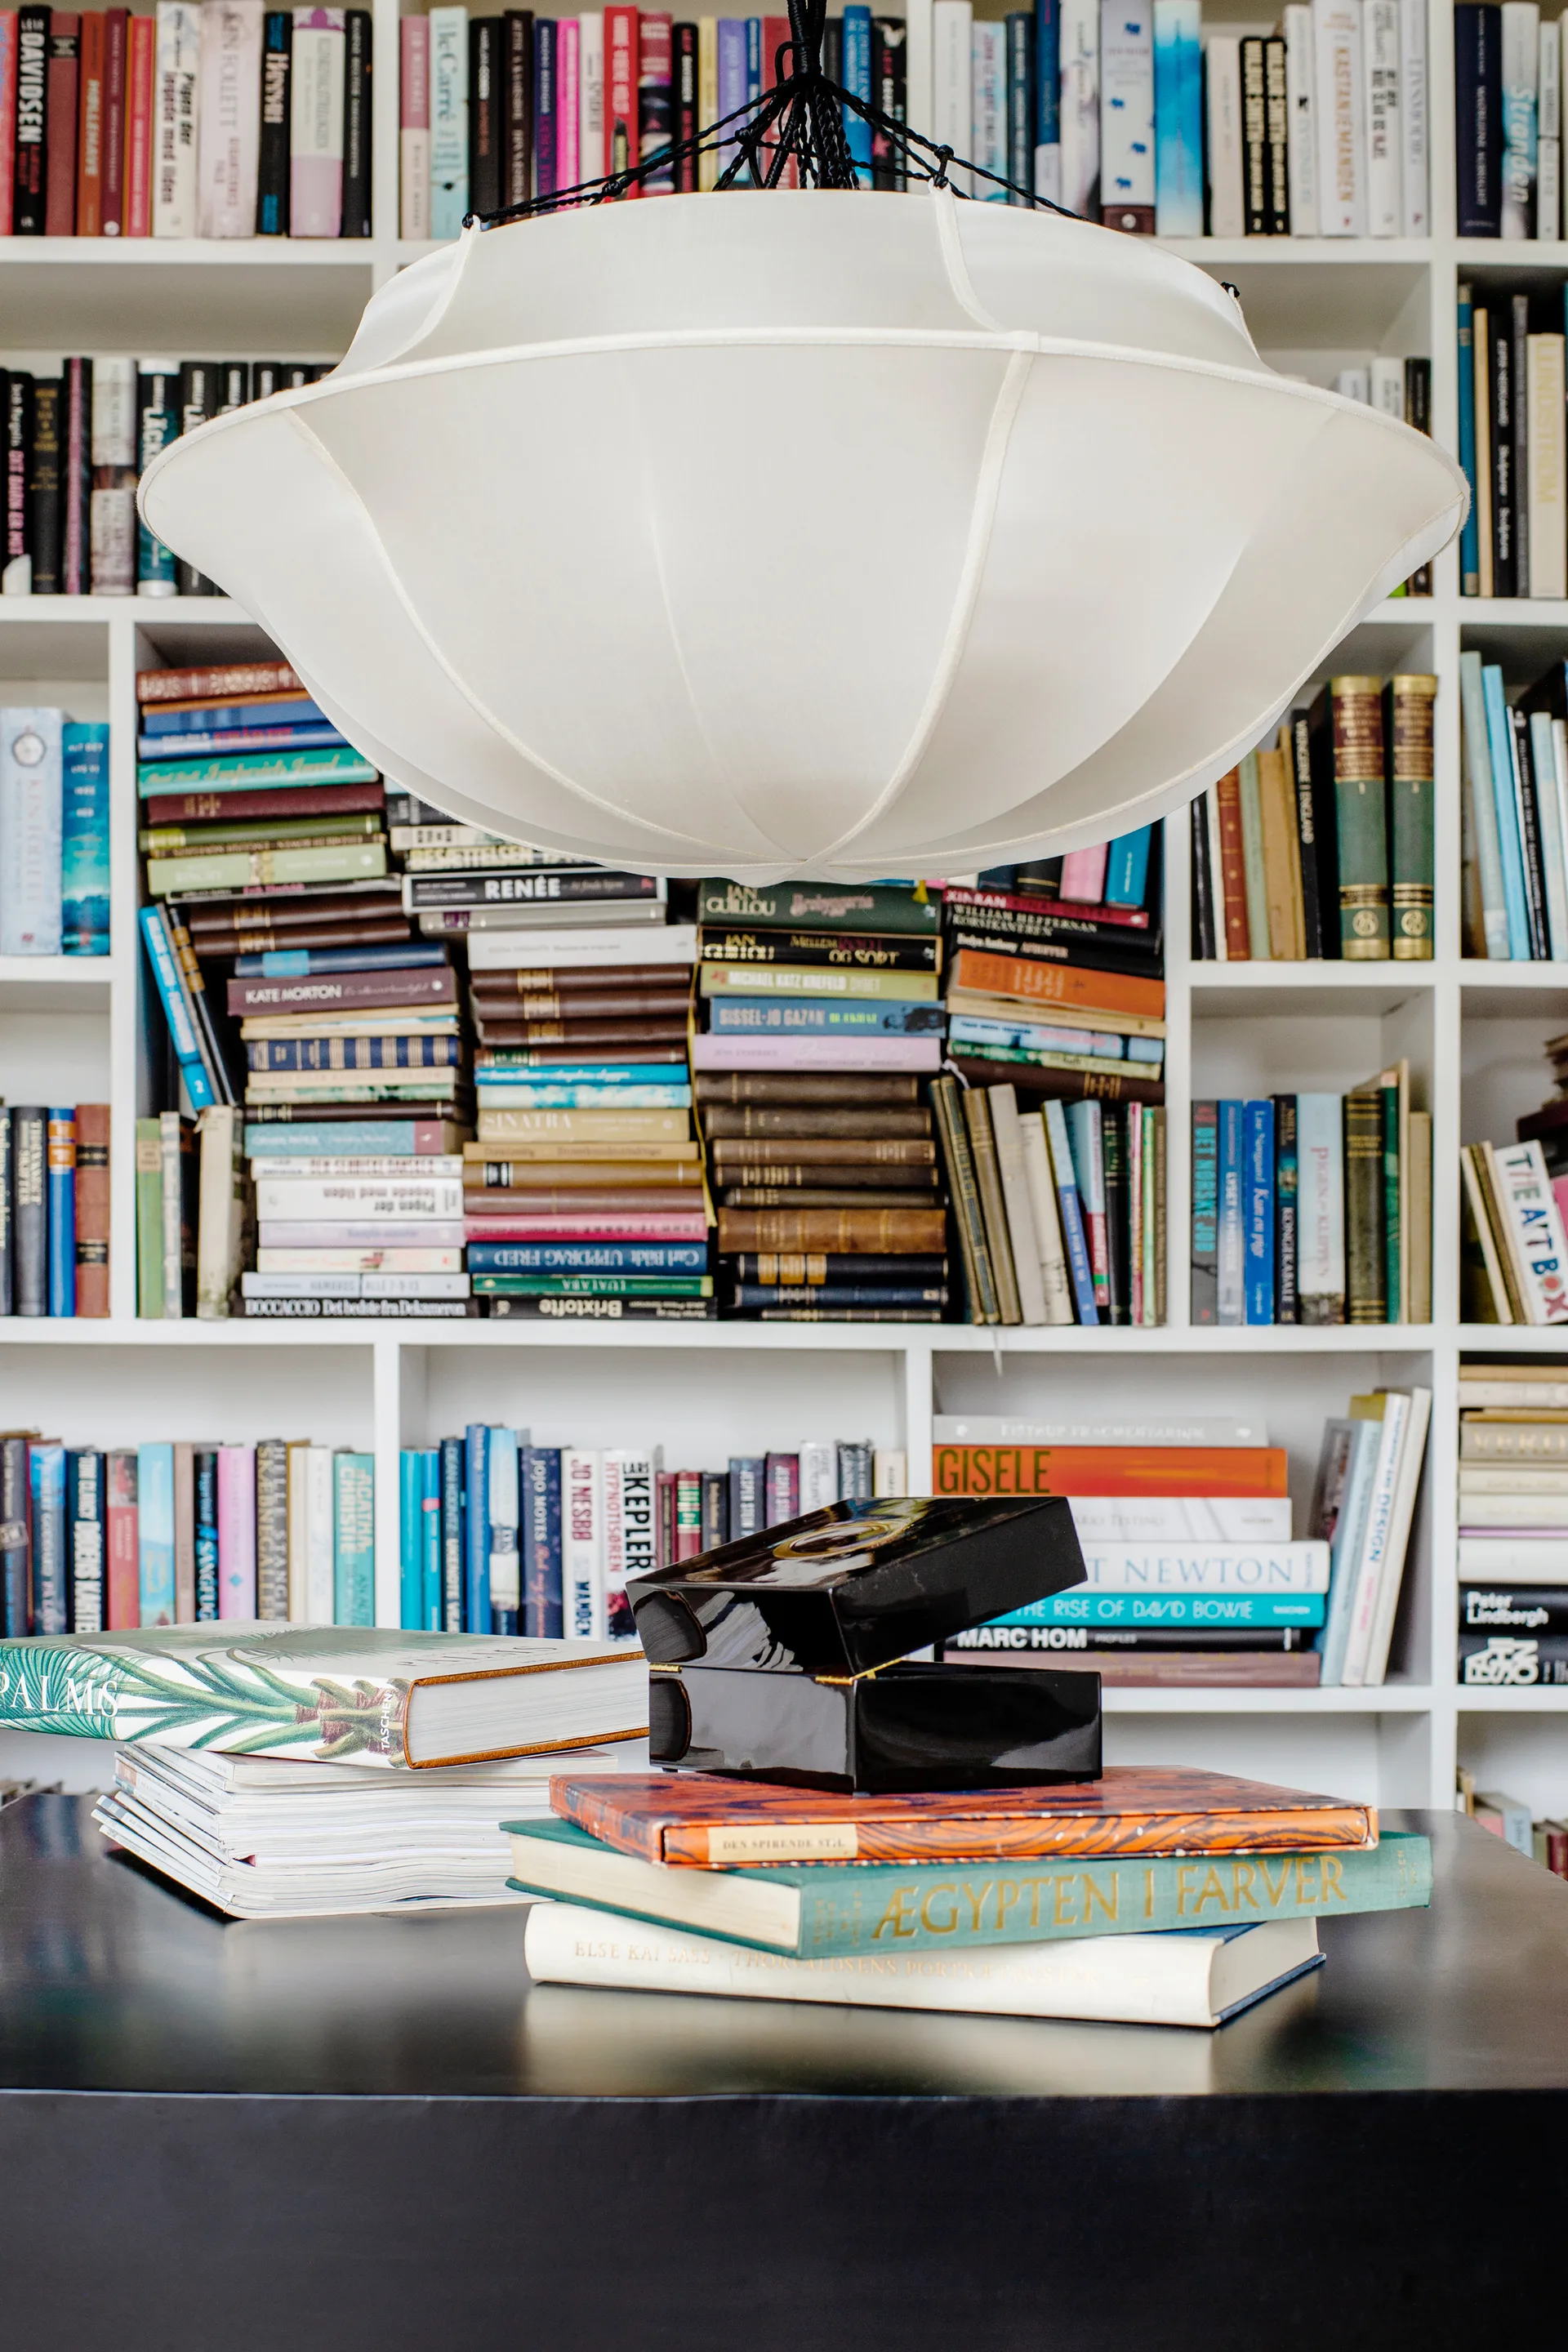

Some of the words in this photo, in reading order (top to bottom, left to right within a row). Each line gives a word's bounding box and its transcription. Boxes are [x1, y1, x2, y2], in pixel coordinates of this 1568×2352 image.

[1244, 41, 1263, 96] WILBUR
[1267, 42, 1285, 96] WILBUR
[19, 33, 44, 143] DAVIDSEN
[220, 54, 240, 128] FOLLETT
[180, 122, 193, 145] der
[1245, 97, 1264, 143] SMITH
[1268, 99, 1286, 144] SMITH
[1334, 47, 1354, 203] KASTANJEMANDEN
[164, 128, 176, 159] med
[1509, 85, 1535, 204] Stranden
[141, 408, 168, 471] LÄCK
[7, 511, 24, 530] ER
[1295, 719, 1311, 784] VIKINGERNE
[1298, 792, 1314, 844] ENGLAND
[484, 875, 561, 899] RENÉE
[727, 884, 758, 899] JAN
[947, 889, 1007, 909] XINRAN
[706, 898, 776, 916] GUILLOU
[953, 903, 1013, 921] WILLIAM
[1016, 911, 1098, 933] HEFFERNAN
[704, 946, 774, 960] GUILLOU
[726, 933, 756, 945] JAN
[790, 936, 837, 948] MELLEM
[829, 950, 852, 963] OG
[854, 950, 900, 964] SORT
[245, 989, 279, 1004] KATE
[281, 985, 342, 1003] MORTON
[728, 971, 773, 987] MICHAEL
[776, 973, 802, 989] KATZ
[483, 1113, 572, 1129] SINATRA
[1194, 1127, 1216, 1155] DET
[1194, 1159, 1216, 1218] NORSKE
[1226, 1171, 1237, 1205] LYSET
[1253, 1187, 1270, 1214] Kun
[1195, 1222, 1216, 1252] JOB
[1254, 1217, 1265, 1232] en
[1505, 1152, 1539, 1201] THE
[1530, 1258, 1566, 1318] BOX
[493, 1250, 541, 1266] FRED
[546, 1248, 623, 1267] UPPDRAG
[631, 1249, 666, 1267] Bildt
[669, 1249, 700, 1265] Carl
[1250, 1233, 1267, 1258] pige
[1281, 1207, 1294, 1303] KONGEKABALE
[246, 1299, 320, 1316] BOCCACCIO
[323, 1299, 345, 1315] Det
[539, 1299, 622, 1317] Brixtofte
[78, 1455, 96, 1479] TOM
[445, 1446, 458, 1482] DEAN
[530, 1458, 547, 1493] JOJO
[572, 1459, 591, 1479] JO
[938, 1450, 1051, 1494] GISELE
[274, 1446, 287, 1518] HELLE
[740, 1470, 755, 1501] JESPER
[775, 1466, 791, 1497] JESPER
[78, 1480, 96, 1520] CLANCY
[340, 1466, 356, 1555] CHRISTIE
[357, 1470, 373, 1553] AGATHA
[572, 1486, 592, 1541] NESBØ
[741, 1503, 755, 1527] STEIN
[256, 1446, 274, 1619] SKÆBNEGALLER
[533, 1495, 547, 1542] MOYES
[606, 1462, 622, 1572] HYPNOTISØREN
[624, 1477, 651, 1570] KEPLER
[1369, 1493, 1391, 1564] DESIGN
[74, 1521, 100, 1579] DØDENS
[199, 1539, 216, 1622] SANGFUG
[274, 1530, 287, 1622] STANGE
[1124, 1557, 1293, 1585] NEWTON
[74, 1581, 100, 1634] KARTE
[1054, 1600, 1090, 1617] RISE
[1098, 1600, 1124, 1617] OF
[1133, 1600, 1186, 1617] DAVID
[1192, 1600, 1254, 1618] BOWIE
[1467, 1591, 1512, 1609] Peter
[1467, 1609, 1549, 1628] Lindbergh
[957, 1628, 1026, 1649] MARC
[1031, 1628, 1087, 1649] HOM
[379, 1692, 394, 1751] TASCHEN
[723, 1839, 747, 1851] DEN
[751, 1839, 813, 1850] SPIRENDE
[817, 1838, 846, 1849] STIL
[871, 1871, 1120, 1940] ÆGYPTEN
[1143, 1869, 1155, 1919] I
[1176, 1854, 1349, 1917] FARVER
[574, 1940, 621, 1959] ELSE
[627, 1942, 660, 1962] KAI
[668, 1946, 712, 1966] SASS
